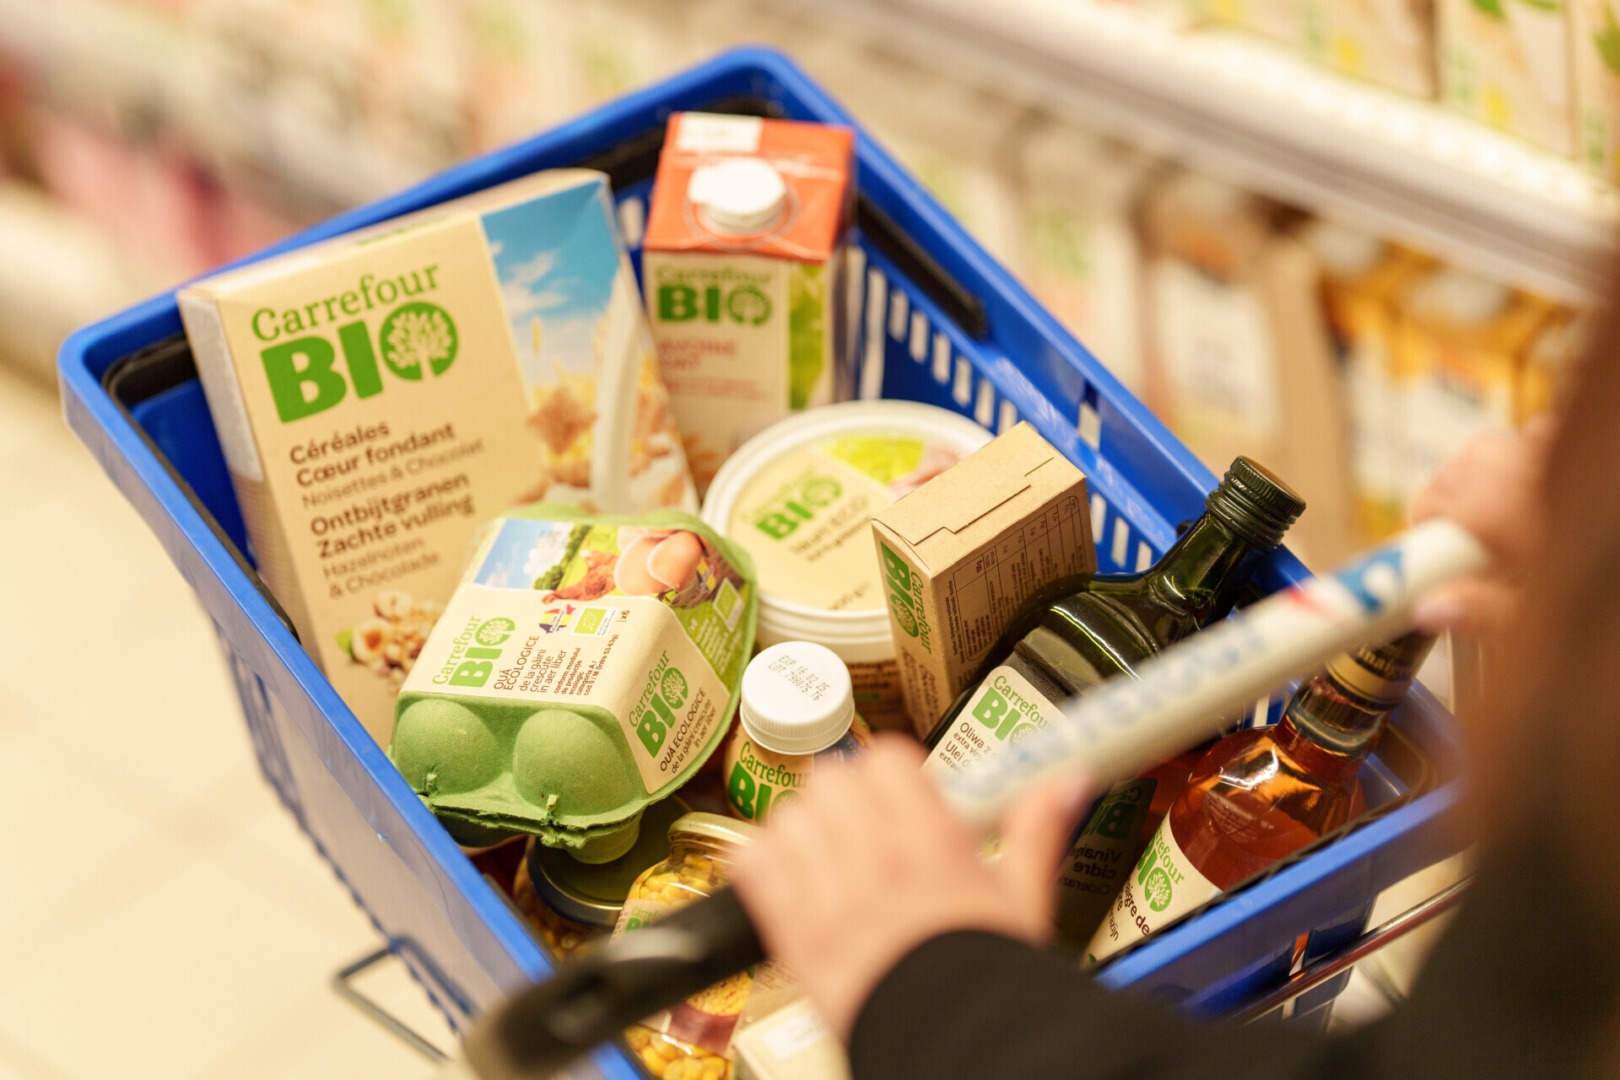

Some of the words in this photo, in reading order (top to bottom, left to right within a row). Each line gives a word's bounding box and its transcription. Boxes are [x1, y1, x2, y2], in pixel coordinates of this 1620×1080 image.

[252, 262, 440, 342] Carrefour
[658, 283, 773, 327] BIO
[260, 302, 459, 424] BIO
[290, 420, 390, 464] Céréales
[296, 453, 360, 487] Cœur
[365, 422, 455, 466] fondant
[302, 470, 388, 510] Noisettes
[390, 465, 403, 480] &
[405, 438, 484, 475] Chocolat
[310, 471, 470, 536] Ontbijtgranen
[756, 476, 843, 540] BIO
[317, 521, 397, 559] Zachte
[400, 494, 475, 532] vulling
[322, 537, 425, 580] Hazelnoten
[329, 582, 343, 599] &
[344, 552, 440, 594] Chocolade
[880, 541, 919, 638] BIO
[911, 571, 932, 655] Carrefour
[432, 615, 482, 685] Carrefour
[448, 617, 516, 688] BIO
[503, 635, 539, 691] ECOLOGICE
[550, 649, 567, 669] liber
[768, 661, 786, 673] LOT
[778, 655, 797, 665] EXP
[493, 668, 512, 690] OUĂ
[520, 680, 531, 692] de
[524, 671, 536, 680] la
[530, 655, 554, 693] crescute
[544, 670, 557, 684] aer
[554, 671, 570, 694] conform
[569, 671, 584, 695] ecologic
[576, 670, 592, 696] categoria
[628, 650, 670, 728] Carrefour
[636, 666, 689, 758] BIO
[700, 724, 708, 740] aer
[706, 706, 717, 726] liber
[993, 674, 1050, 730] Carrefou
[660, 745, 676, 772] OUĂ
[672, 686, 706, 748] ECOLOGICE
[671, 761, 680, 774] de
[677, 753, 685, 763] la
[693, 699, 712, 735] crescute
[945, 740, 965, 762] Ulei
[953, 732, 970, 750] extra
[960, 722, 985, 749] Oliwa
[1135, 914, 1151, 936] de
